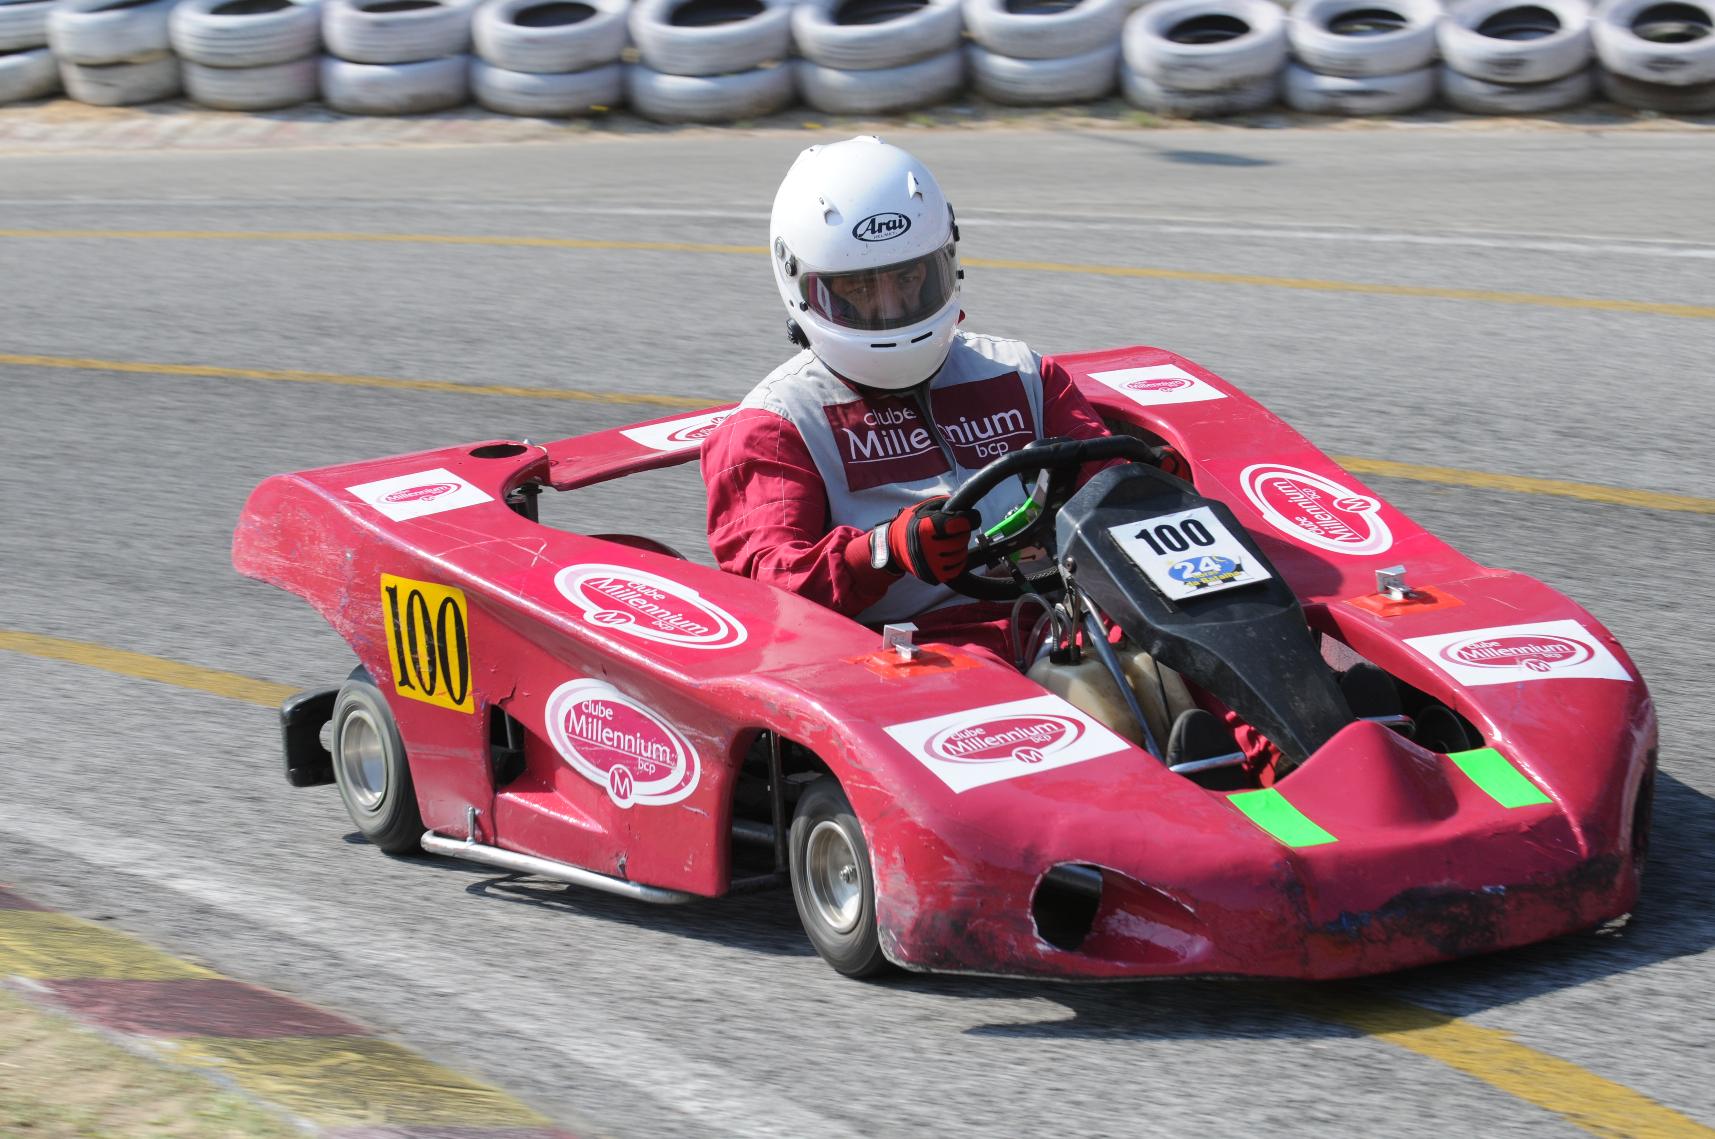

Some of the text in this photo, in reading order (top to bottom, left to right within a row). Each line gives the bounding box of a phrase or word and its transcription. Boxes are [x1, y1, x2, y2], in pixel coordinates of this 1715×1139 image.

[858, 214, 905, 237] Arai
[863, 407, 917, 427] clube
[974, 441, 1009, 458] bcp
[1302, 488, 1322, 500] bcp
[1272, 480, 1361, 541] Millennium
[1295, 515, 1325, 536] clube
[1134, 518, 1216, 556] 100
[1174, 556, 1222, 579] 24
[627, 580, 666, 601] clube
[588, 577, 709, 636] Millennium
[651, 620, 675, 631] bcp
[385, 584, 469, 706] 100
[1457, 642, 1571, 660] Millennium
[581, 700, 613, 720] clube
[568, 708, 672, 764] Millennium
[943, 722, 1059, 755] Millennium
[1030, 734, 1052, 744] bcp
[637, 757, 656, 776] bcp
[613, 770, 631, 800] M
